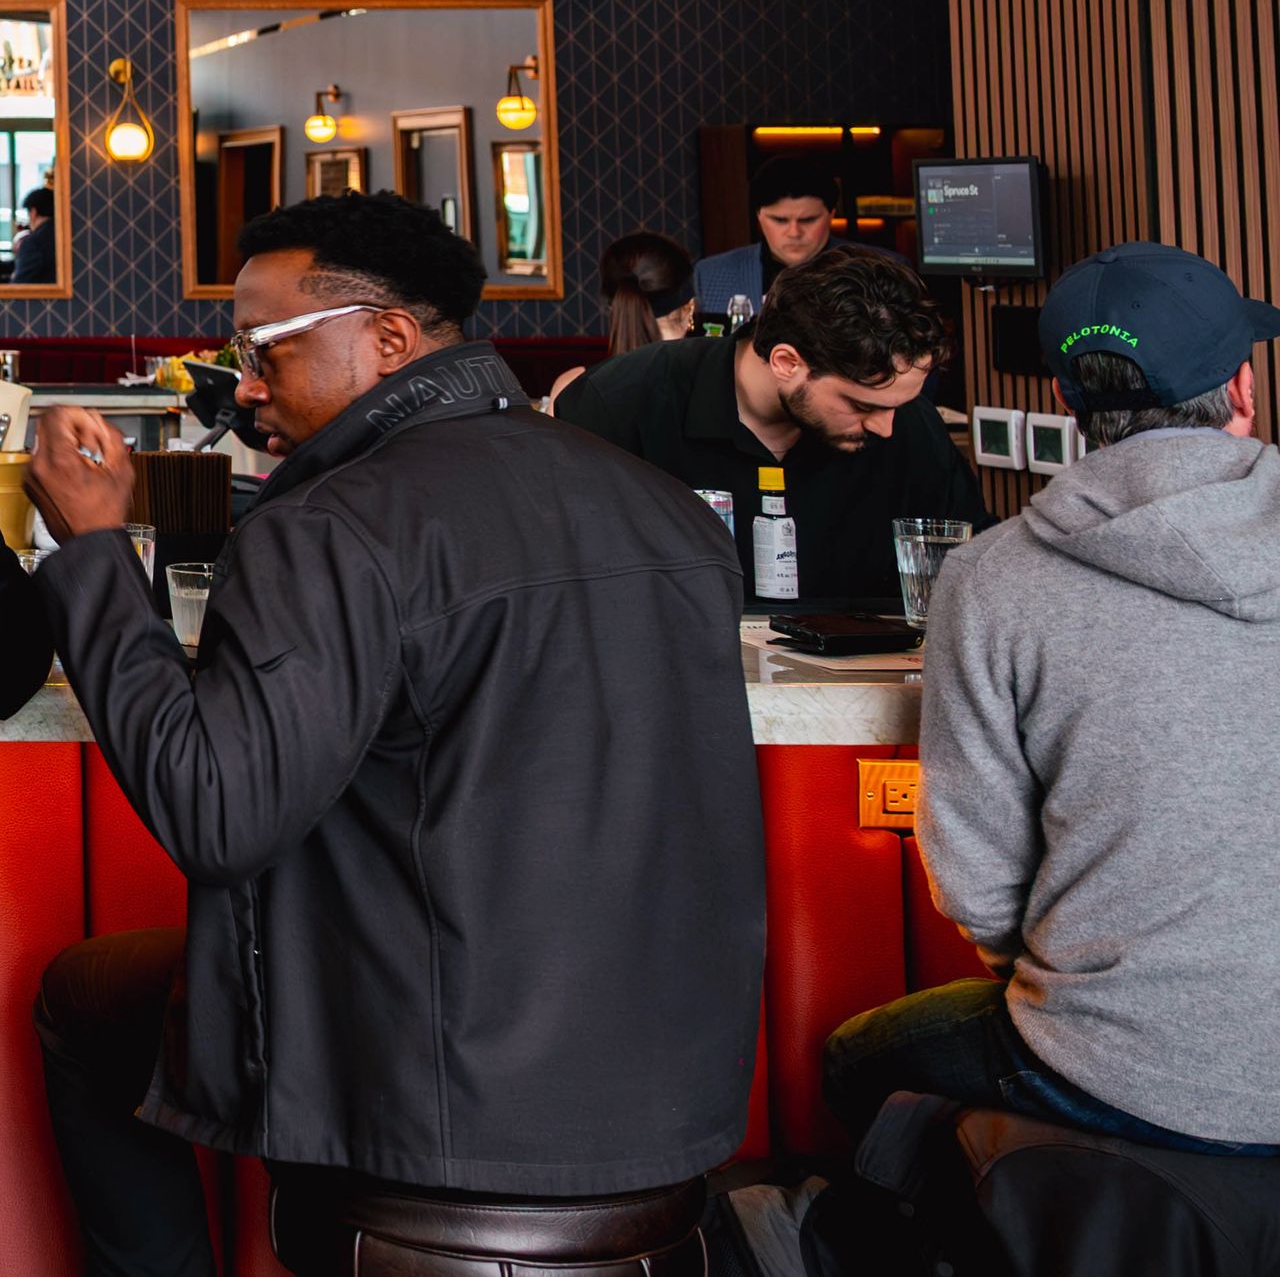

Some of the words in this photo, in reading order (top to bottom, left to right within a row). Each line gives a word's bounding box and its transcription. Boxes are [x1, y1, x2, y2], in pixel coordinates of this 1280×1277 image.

[944, 184, 969, 199] Spruce
[970, 183, 979, 196] St
[1060, 324, 1139, 354] PELOTONIA
